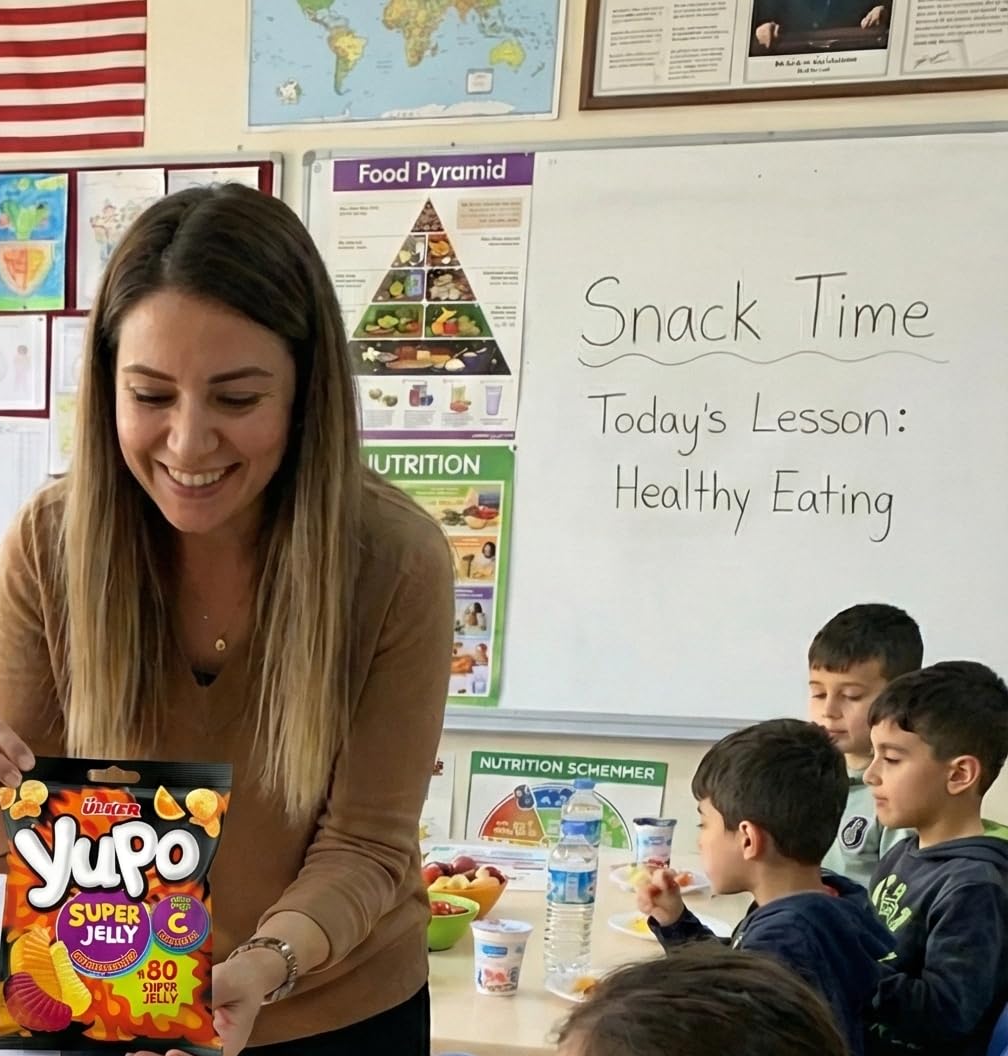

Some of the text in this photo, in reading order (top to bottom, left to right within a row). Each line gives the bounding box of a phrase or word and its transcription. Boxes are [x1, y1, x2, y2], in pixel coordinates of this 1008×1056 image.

[358, 158, 507, 187] Food Pyramid
[582, 272, 935, 346] Snack Time
[588, 392, 906, 456] Today's Lesson:
[616, 464, 894, 542] Healthy Eating
[479, 756, 564, 774] NUTRITION
[68, 902, 141, 927] SUPER
[167, 912, 189, 934] C
[80, 925, 139, 946] JELLY
[147, 960, 178, 981] 80
[143, 992, 179, 1004] JELLY
